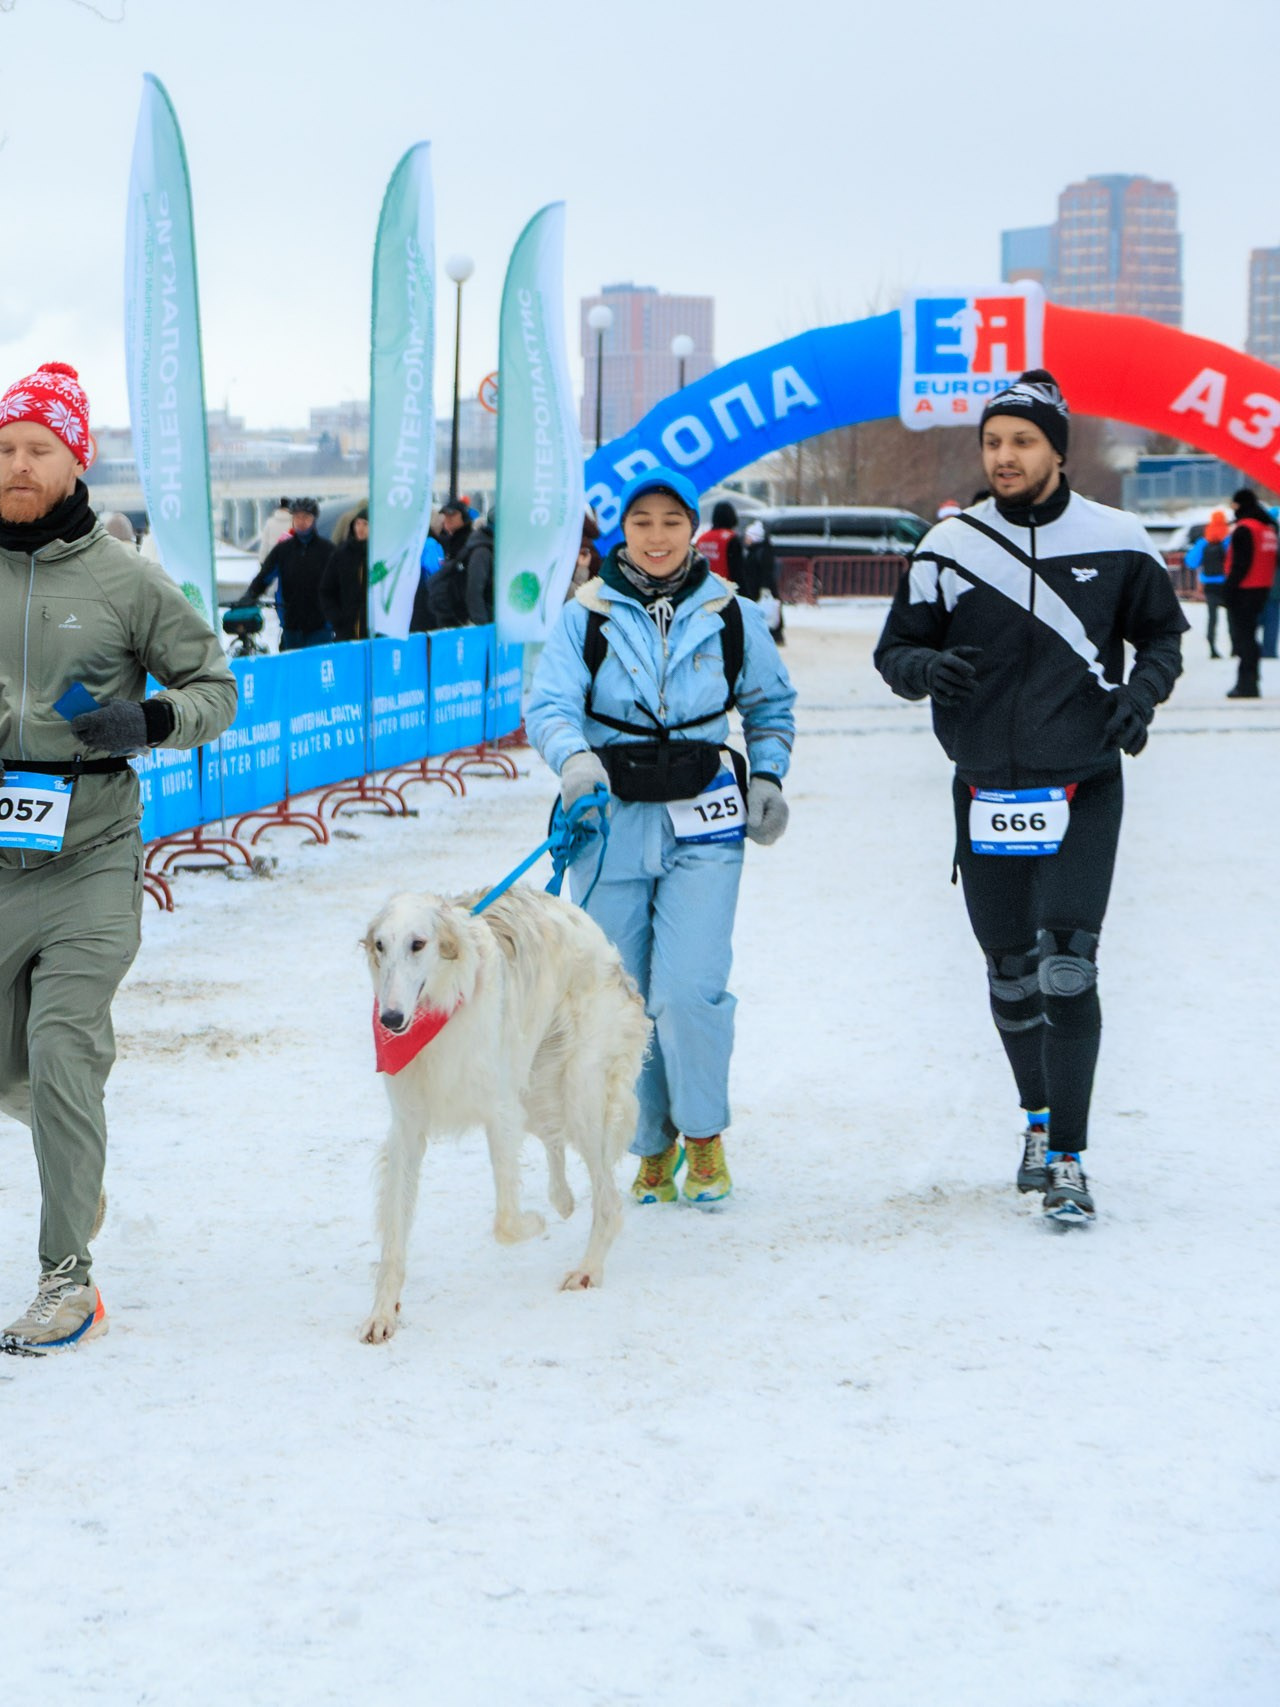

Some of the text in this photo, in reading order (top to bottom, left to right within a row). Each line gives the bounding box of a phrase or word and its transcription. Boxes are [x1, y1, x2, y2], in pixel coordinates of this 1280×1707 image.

[914, 380, 1016, 395] EUROP
[1169, 367, 1280, 462] АЗ
[585, 365, 820, 535] ВРОПА
[693, 796, 739, 823] 125
[991, 812, 1047, 832] 666
